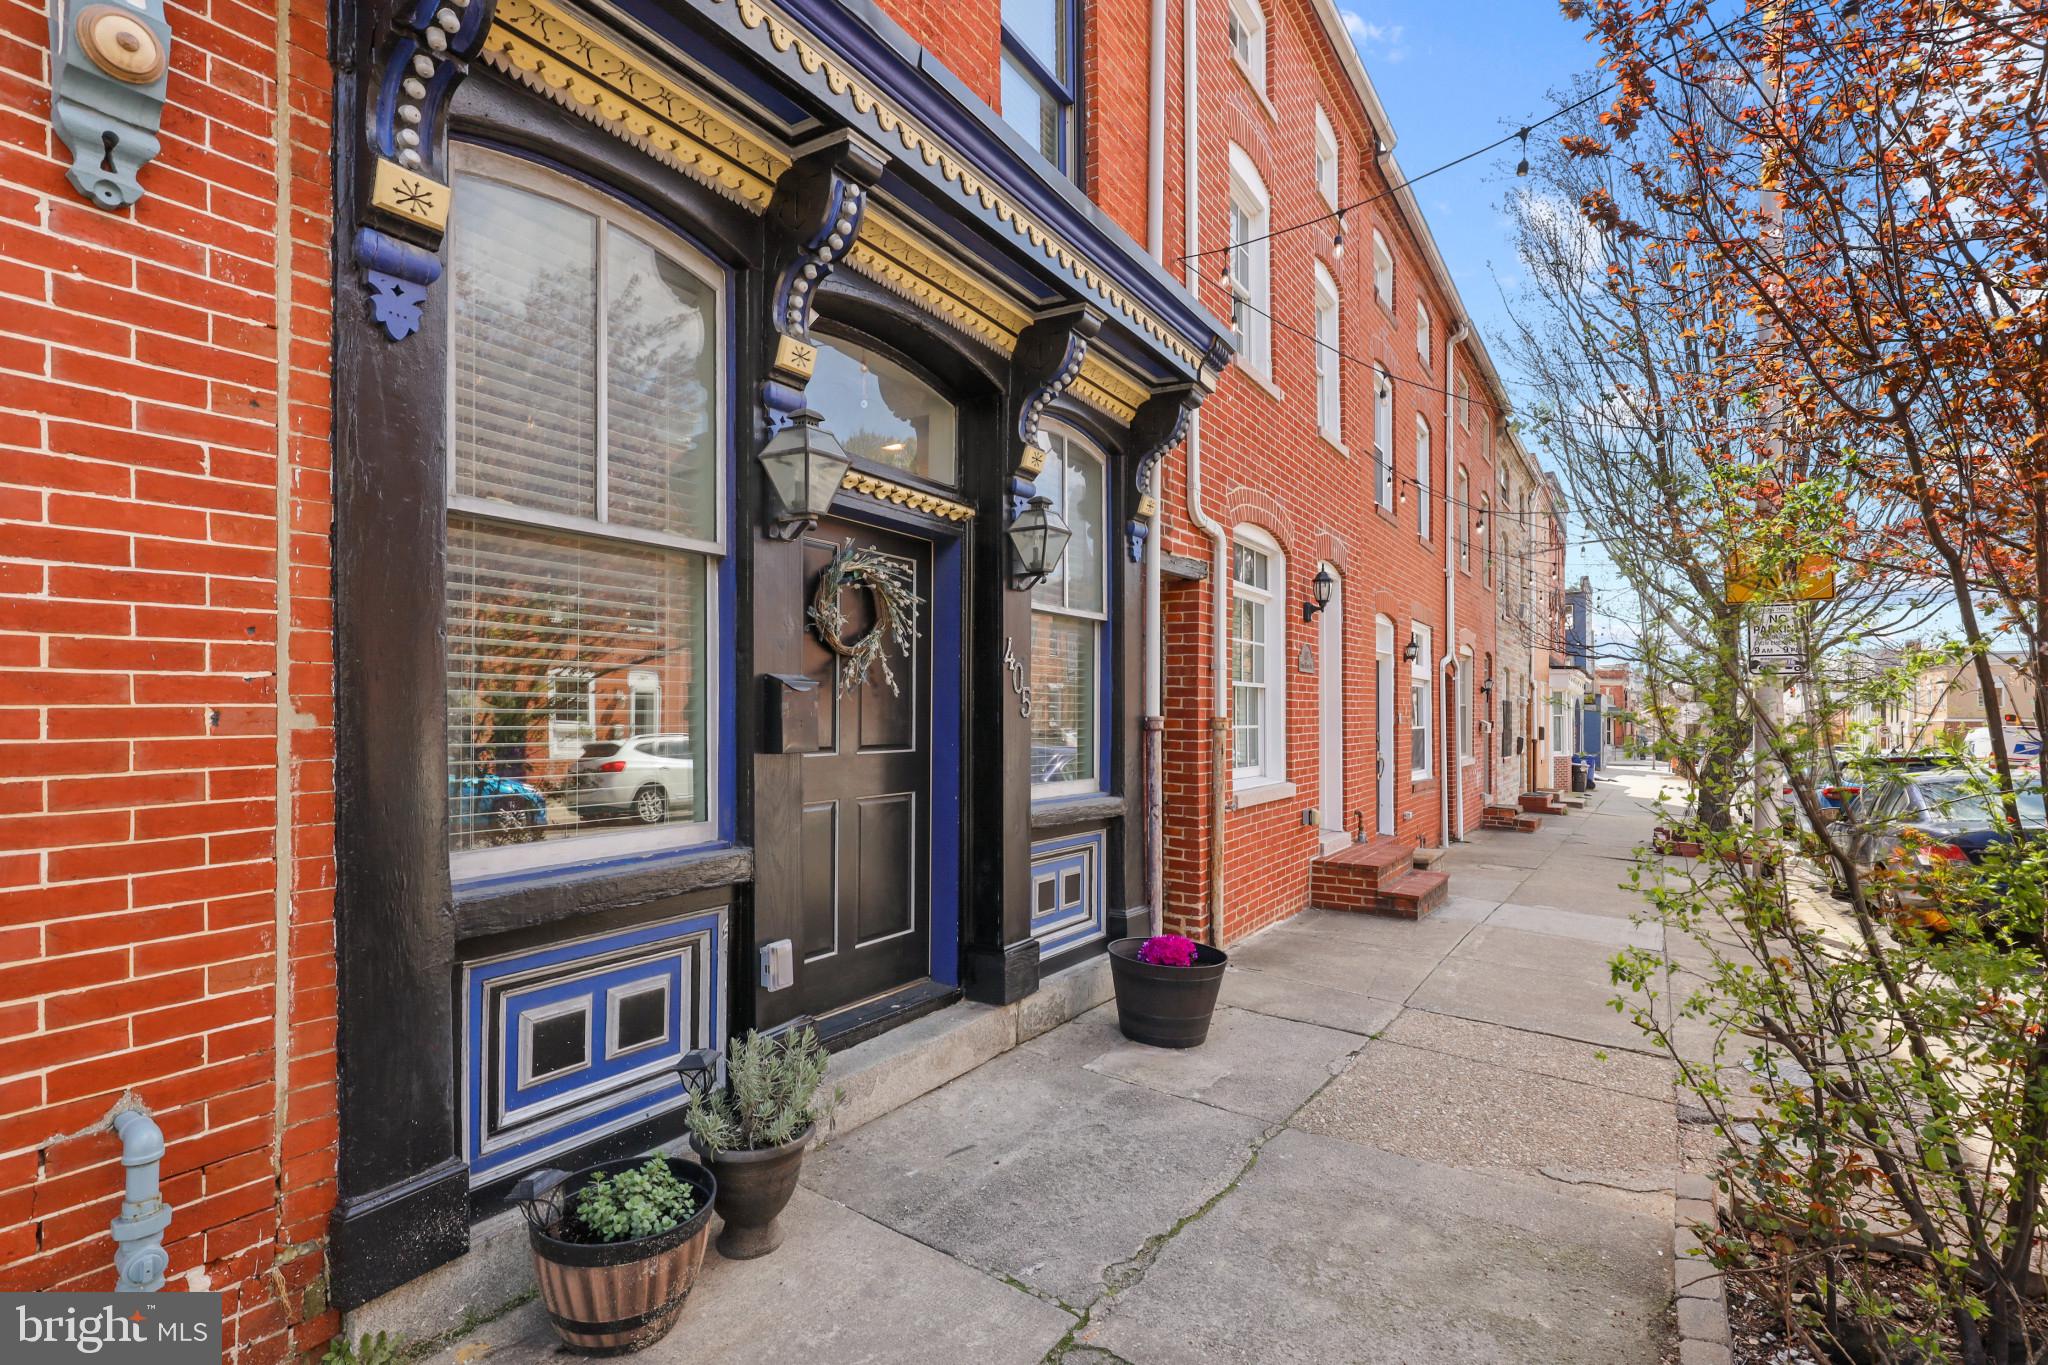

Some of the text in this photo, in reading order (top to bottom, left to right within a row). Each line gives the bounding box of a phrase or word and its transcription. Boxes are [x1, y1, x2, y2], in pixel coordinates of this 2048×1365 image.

[1769, 614, 1787, 623] NO
[1753, 624, 1800, 635] PARKIN
[1754, 646, 1760, 654] 9
[1004, 637, 1031, 718] 405
